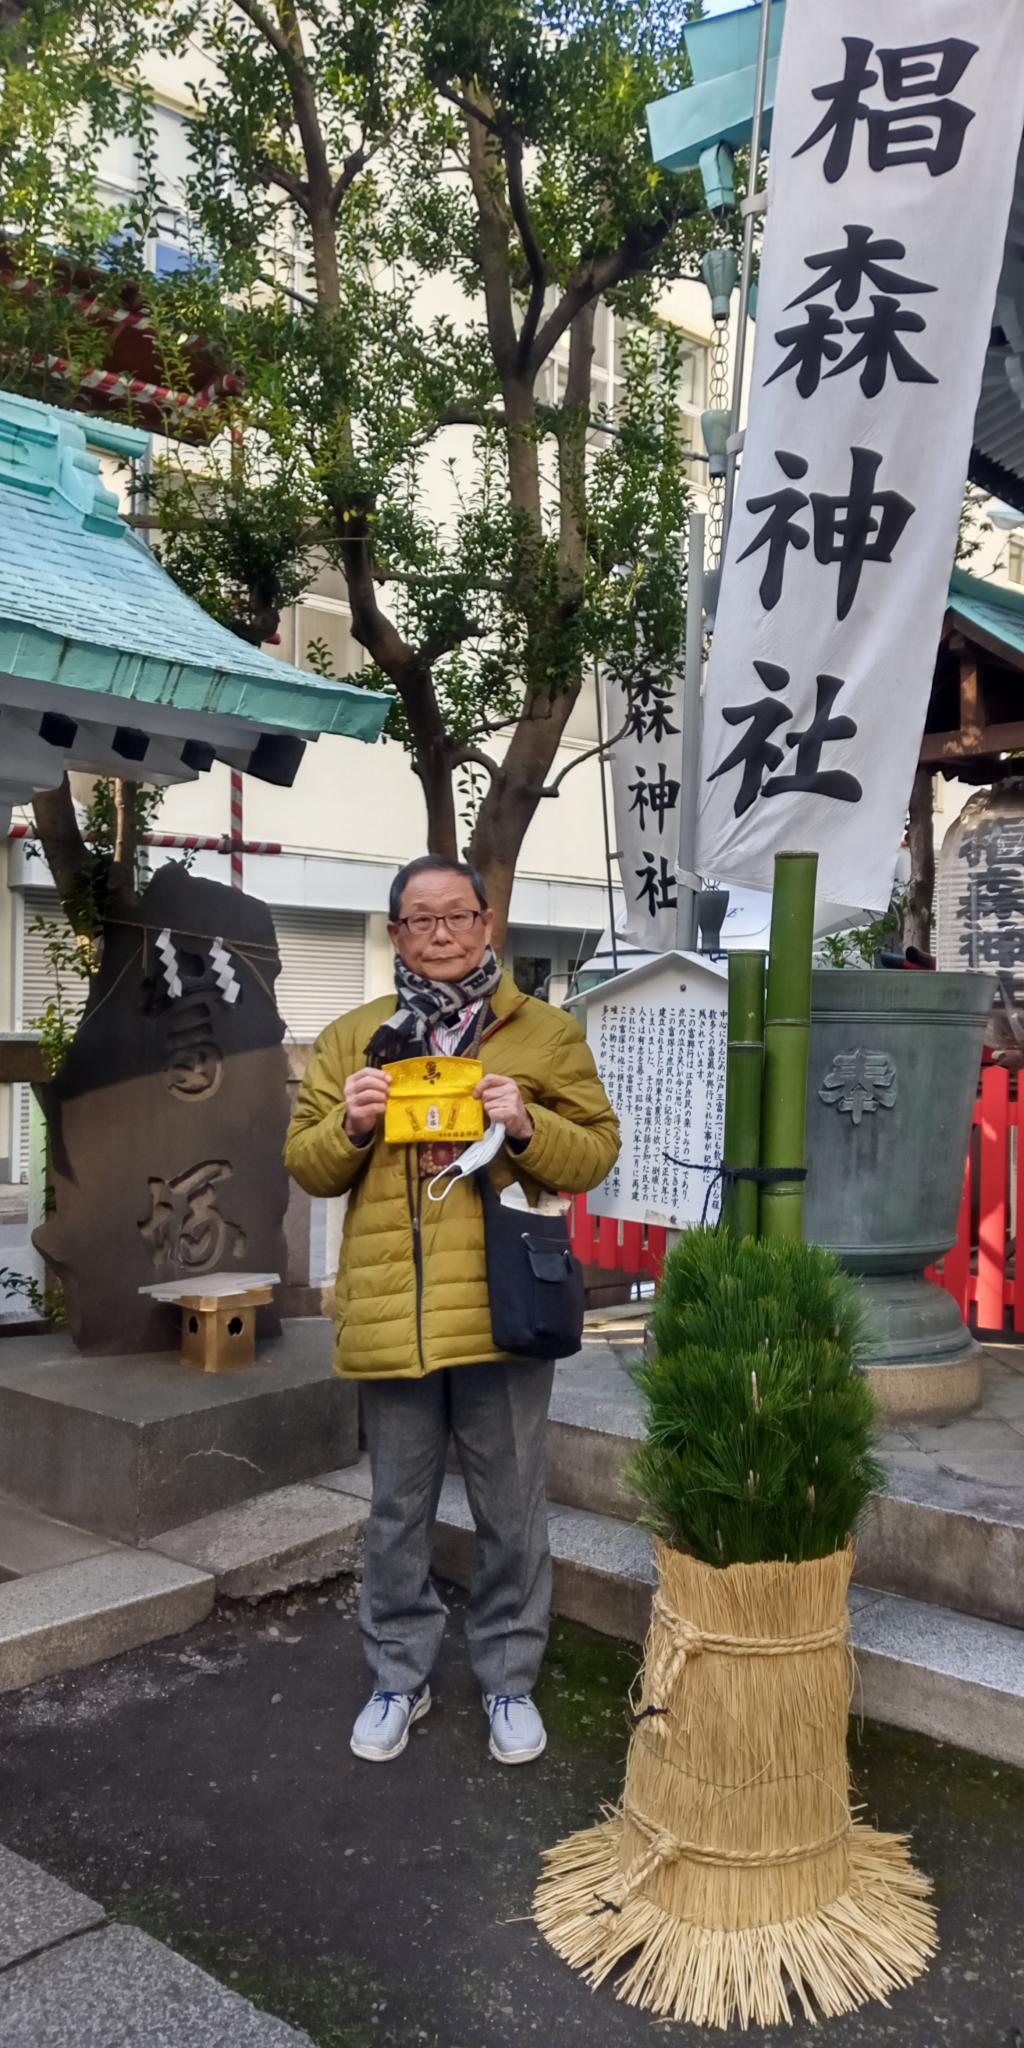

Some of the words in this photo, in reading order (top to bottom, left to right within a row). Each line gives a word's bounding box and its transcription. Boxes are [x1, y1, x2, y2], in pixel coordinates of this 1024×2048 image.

[706, 36, 979, 818] 椙森神社
[624, 635, 682, 918] 森神社
[817, 1046, 898, 1126] 奉
